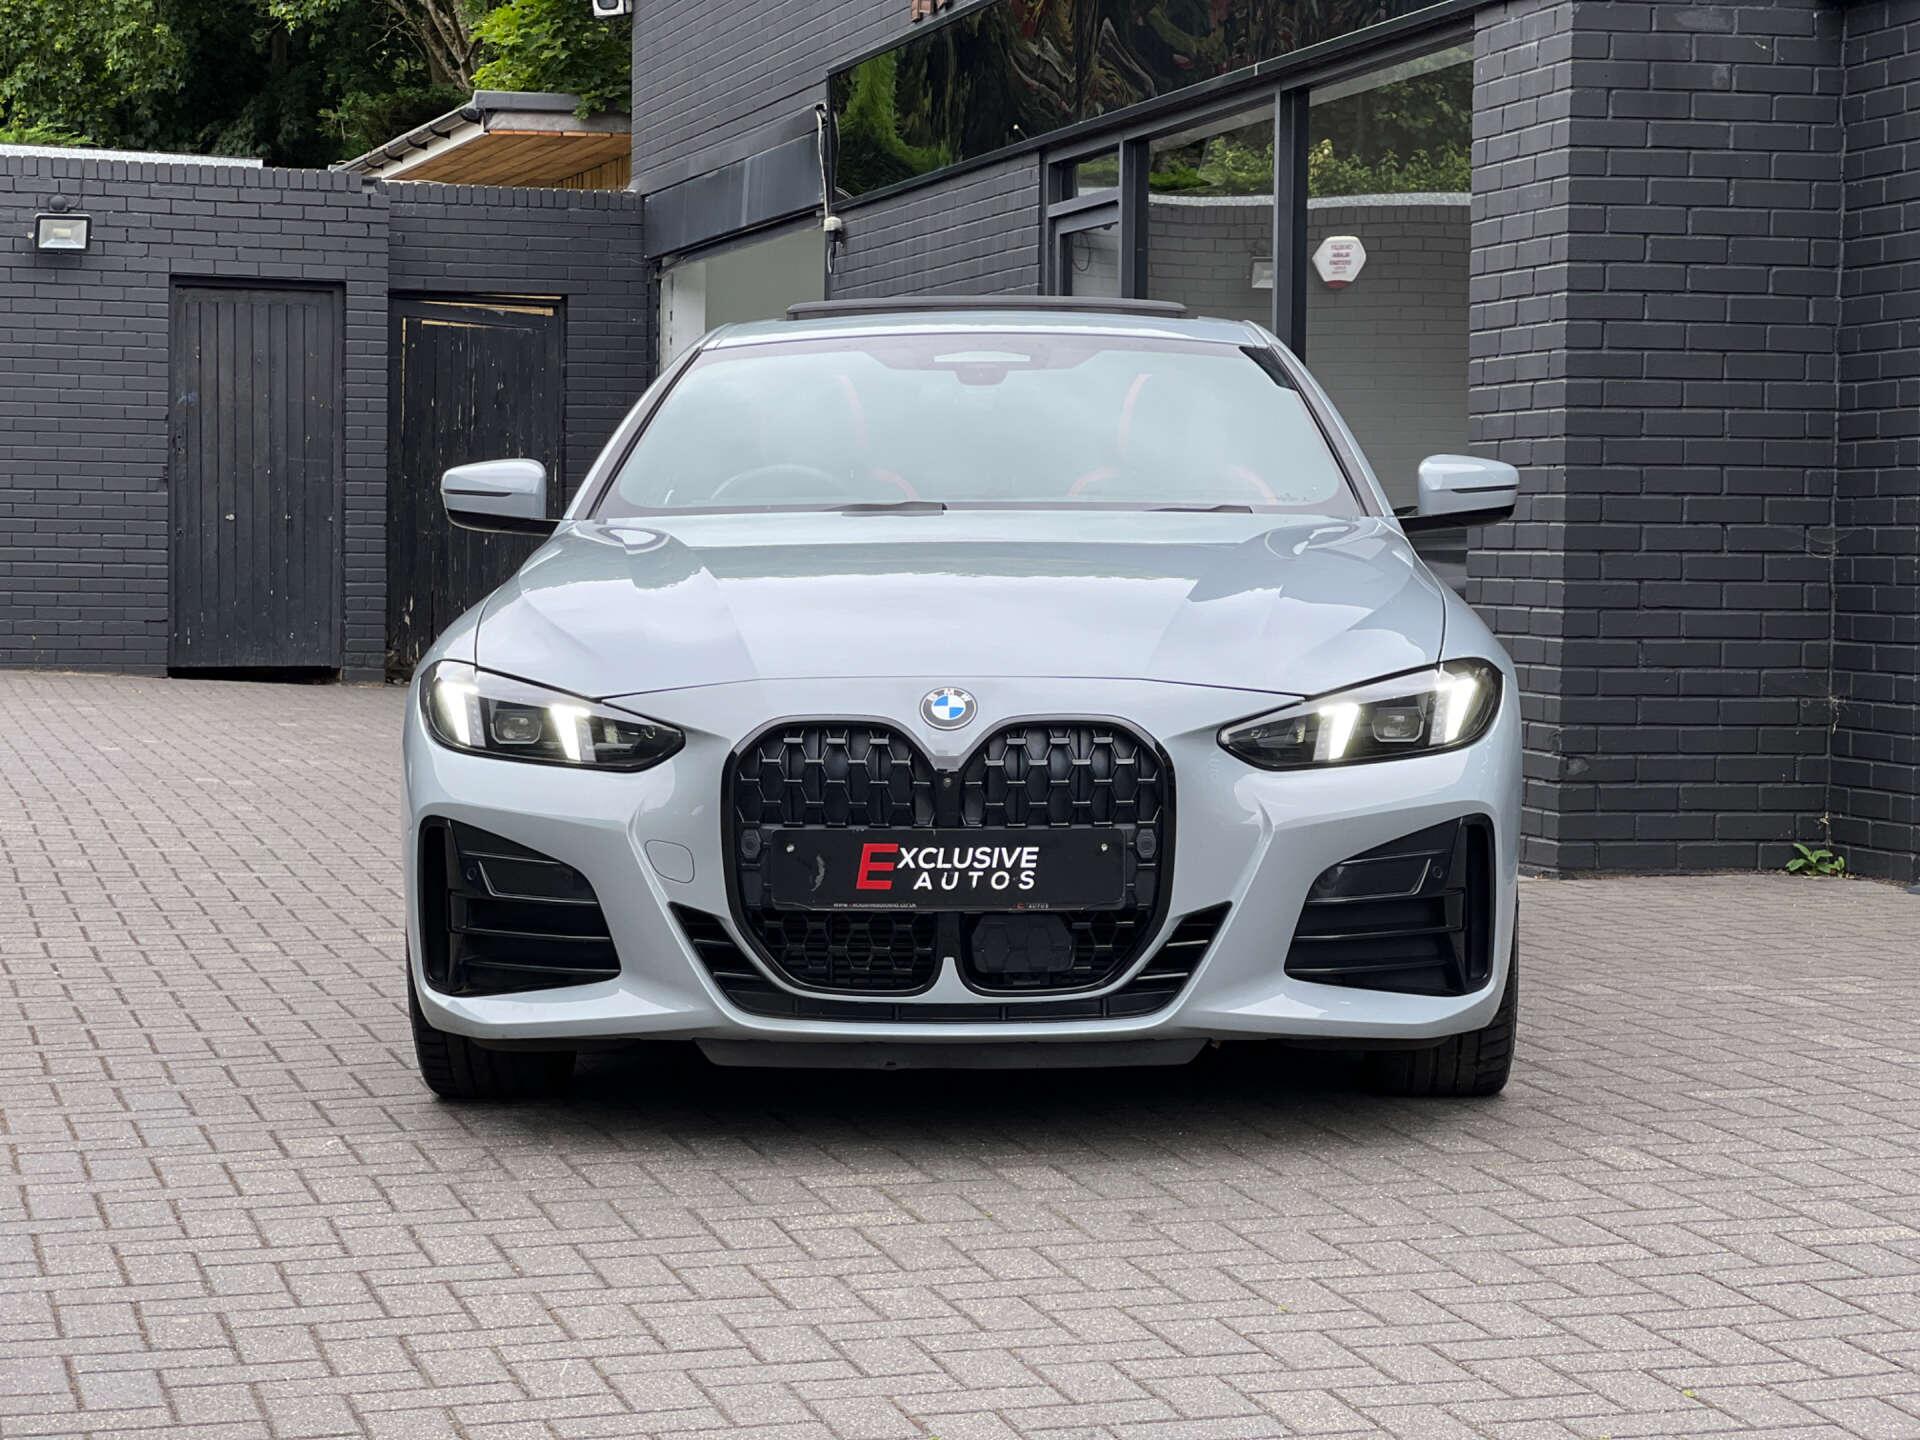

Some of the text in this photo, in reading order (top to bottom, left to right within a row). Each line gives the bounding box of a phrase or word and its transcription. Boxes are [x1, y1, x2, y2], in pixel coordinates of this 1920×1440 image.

[927, 688, 972, 701] BMW
[856, 843, 1039, 890] EXCLUSIVE
[913, 871, 1035, 890] AUTOS
